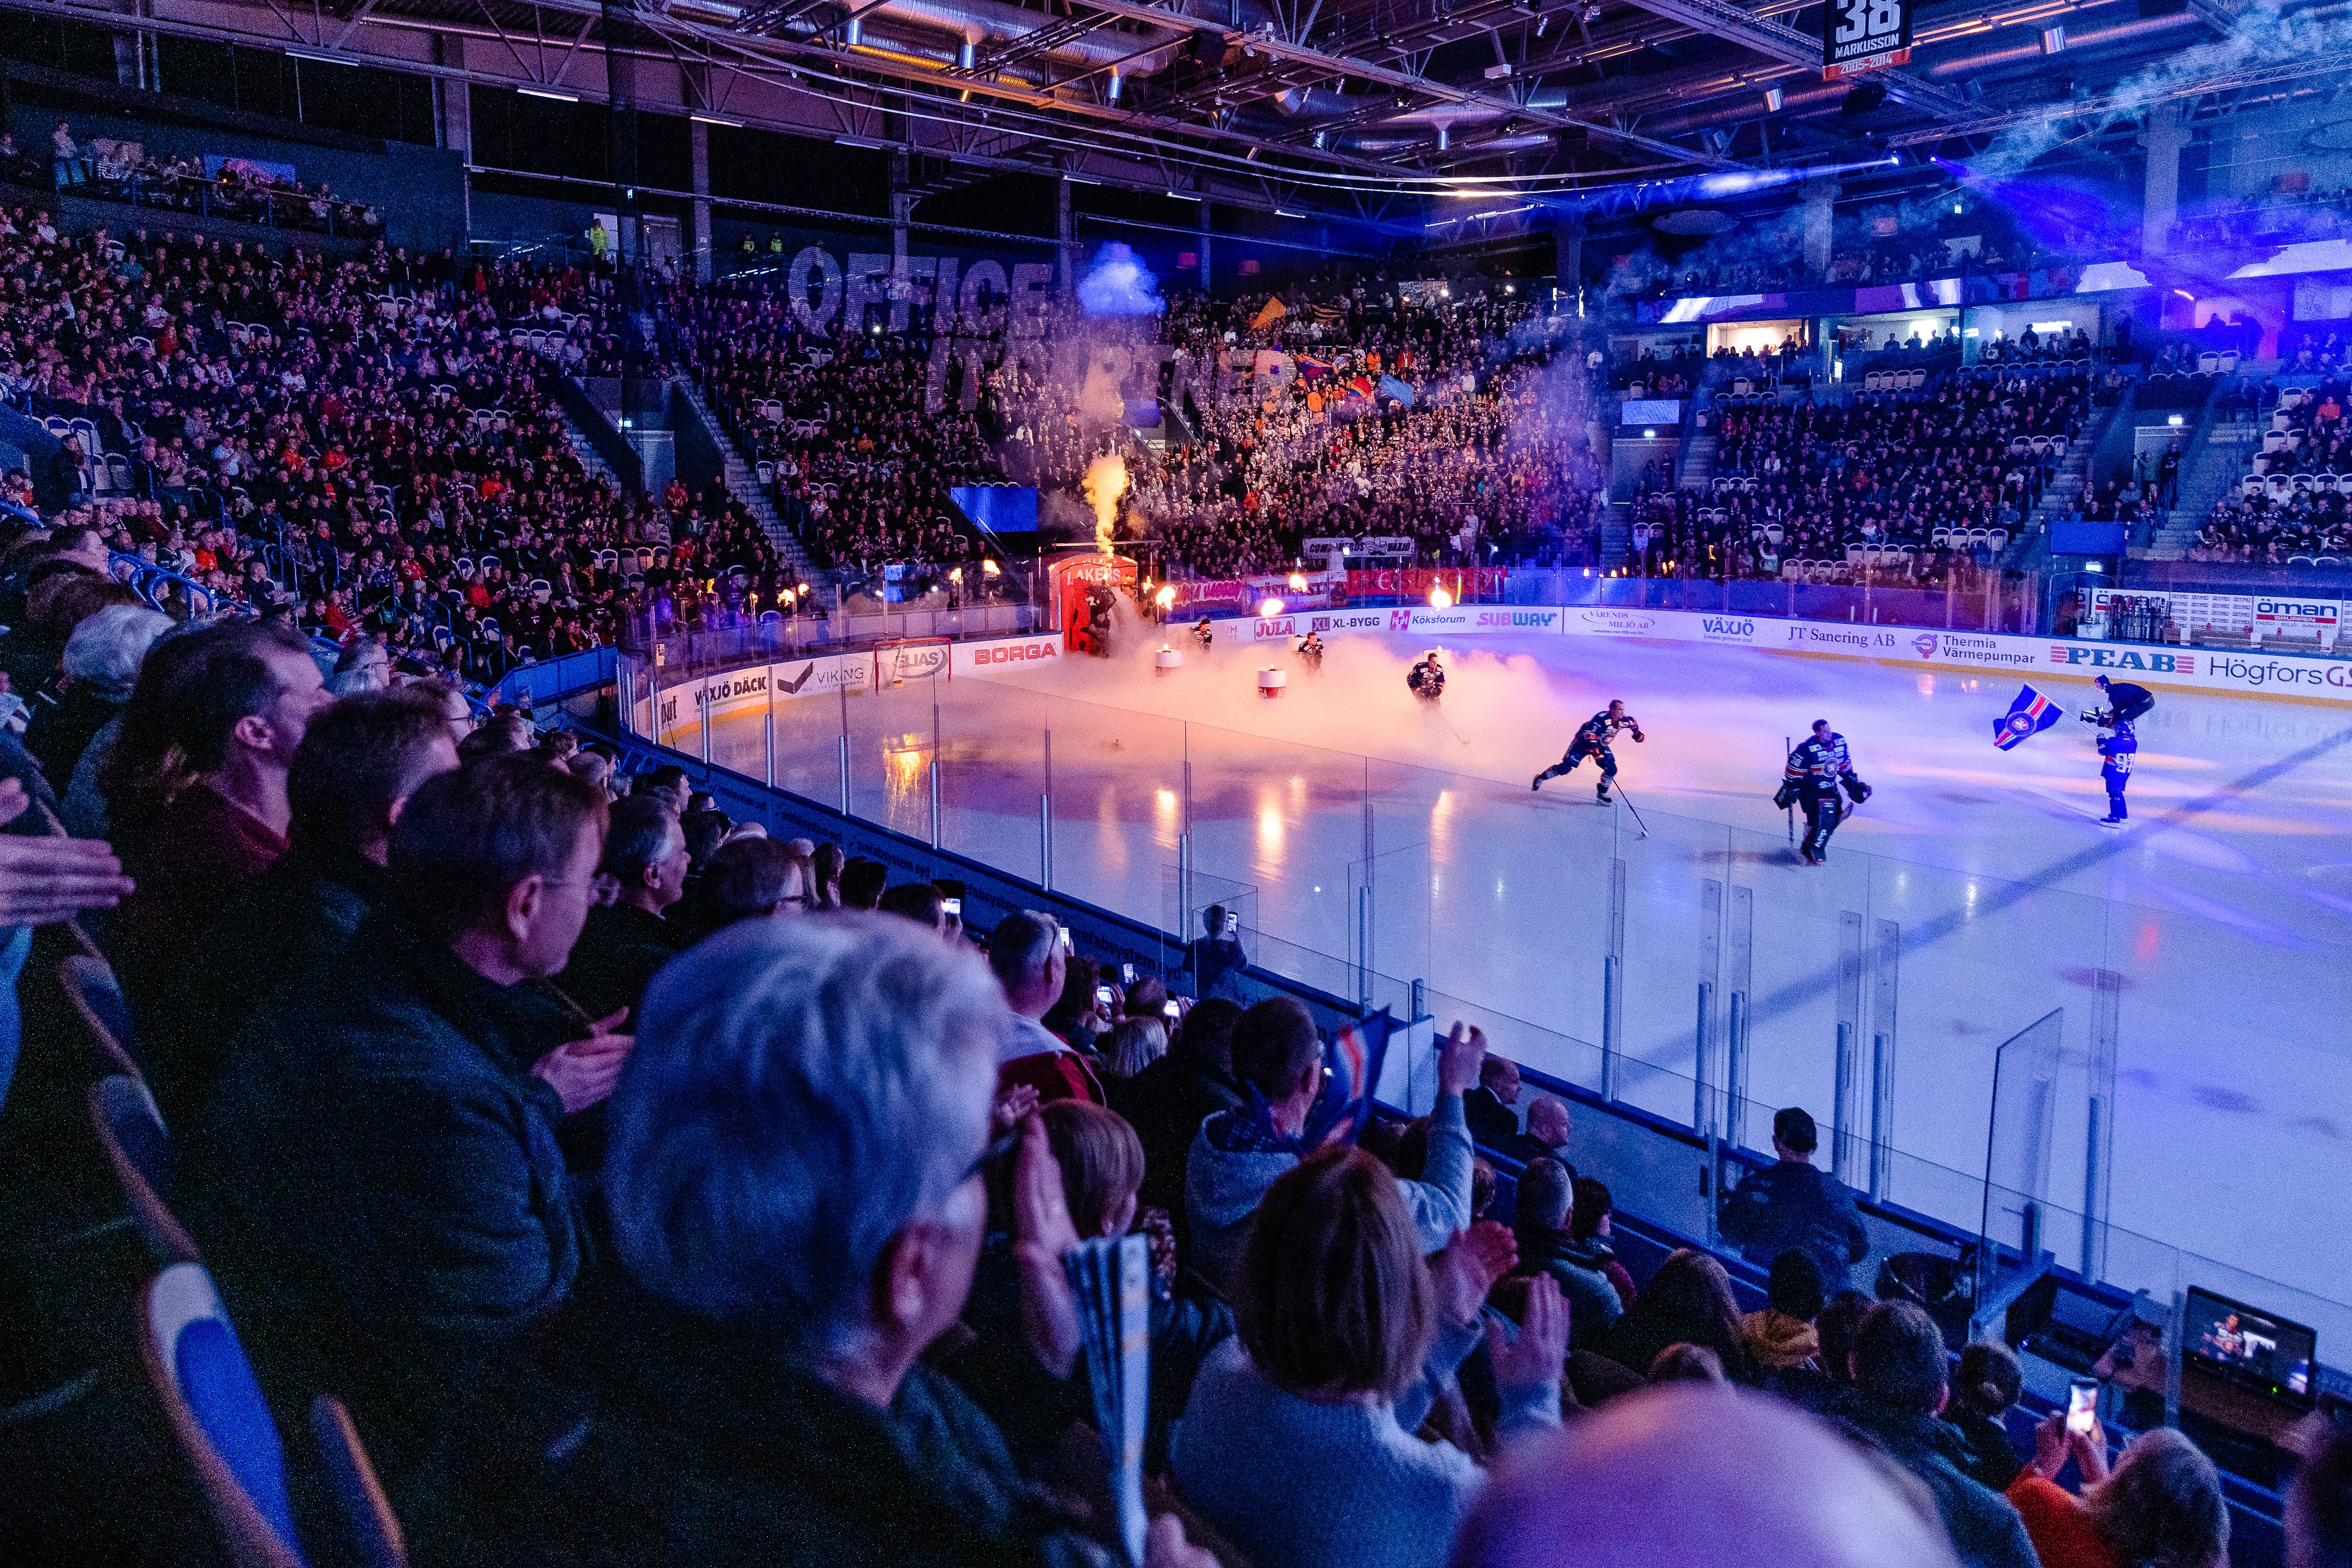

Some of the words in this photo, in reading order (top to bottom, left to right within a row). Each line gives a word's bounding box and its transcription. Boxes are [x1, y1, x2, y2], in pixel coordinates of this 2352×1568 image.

[1836, 0, 1900, 43] 38
[1835, 33, 1899, 59] MARKUSSON
[1841, 54, 1892, 74] 2005-2014
[788, 246, 1053, 337] OFFICE
[1067, 568, 1120, 585] LAKERS
[1590, 609, 1628, 619] VÄRENDS
[2257, 599, 2337, 617] öman
[1333, 617, 1380, 628] XL-BYGG
[1412, 615, 1465, 624] Köksforum
[1477, 612, 1557, 626] SUBWAY
[1609, 619, 1635, 628] MILJÖ
[1703, 617, 1754, 636] VÄXJÖ
[1256, 620, 1294, 638] JULA
[1789, 626, 1807, 641] JT
[1810, 628, 1868, 648] Sanering
[1873, 633, 1895, 647] AB
[1943, 635, 1996, 649] Thermia
[974, 643, 1057, 665] BORGA
[1943, 646, 2035, 664] Värmepumpar
[2065, 647, 2176, 673] PEAB
[817, 667, 864, 684] VIKING
[734, 676, 768, 696] DÄCK
[782, 811, 829, 836] prefabsystem
[830, 831, 842, 843] syd
[857, 841, 913, 871] prefabsystem
[915, 865, 930, 878] syd
[964, 883, 1021, 912] efabsystem
[1070, 926, 1155, 971] prefabsystem
[1158, 961, 1181, 981] syd
